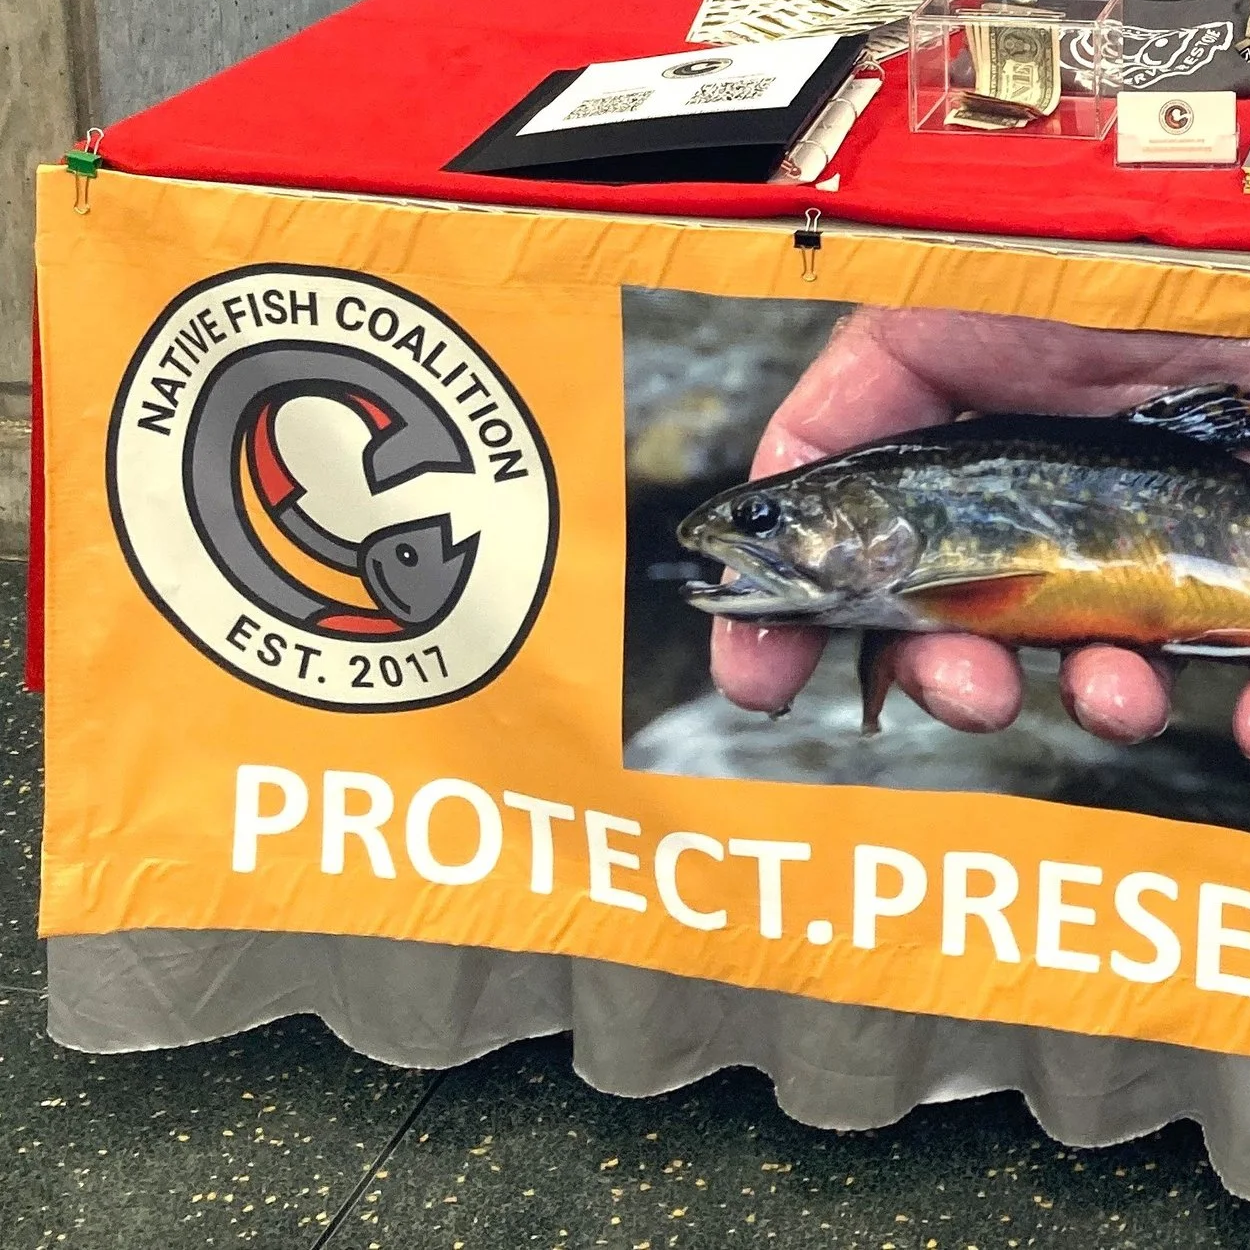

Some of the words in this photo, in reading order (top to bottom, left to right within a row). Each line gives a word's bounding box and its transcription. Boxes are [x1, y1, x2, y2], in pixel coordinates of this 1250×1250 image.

[137, 308, 228, 436] NATIVE
[222, 288, 319, 335] FISH
[335, 296, 529, 484] COALITION
[226, 613, 326, 685] EST.
[349, 645, 450, 688] 2017
